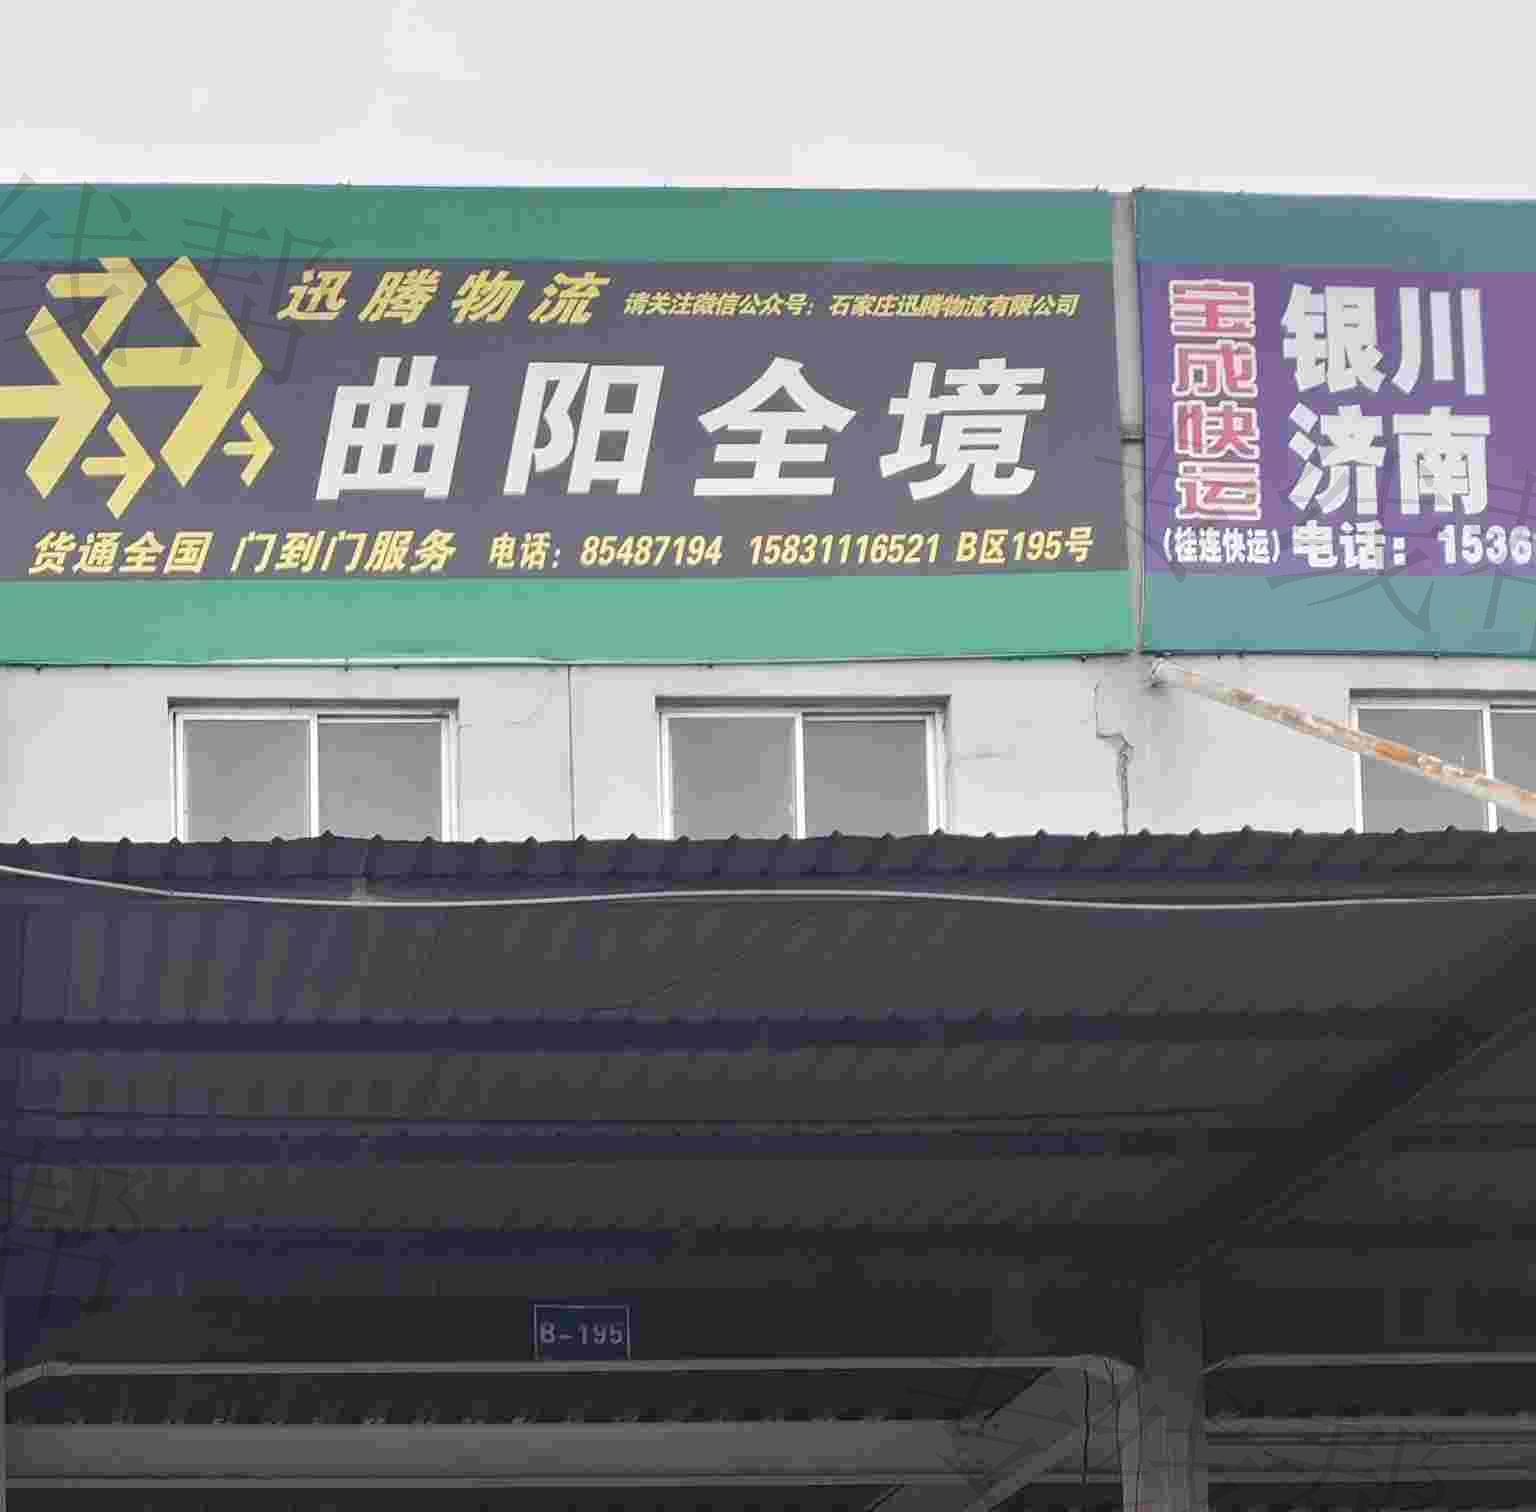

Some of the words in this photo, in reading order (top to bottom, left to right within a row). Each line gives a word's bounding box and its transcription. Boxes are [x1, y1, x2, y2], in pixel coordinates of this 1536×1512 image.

[277, 269, 611, 325] 迅腾物流
[1280, 284, 1486, 395] 银川
[315, 356, 1046, 501] 曲阳全境
[1288, 403, 1490, 515] 济南
[28, 530, 214, 575] 货通全国
[229, 528, 457, 574] 门到门服务
[749, 533, 940, 565] 15831116521
[955, 526, 1094, 565] B区195号
[539, 1319, 623, 1345] B-195
